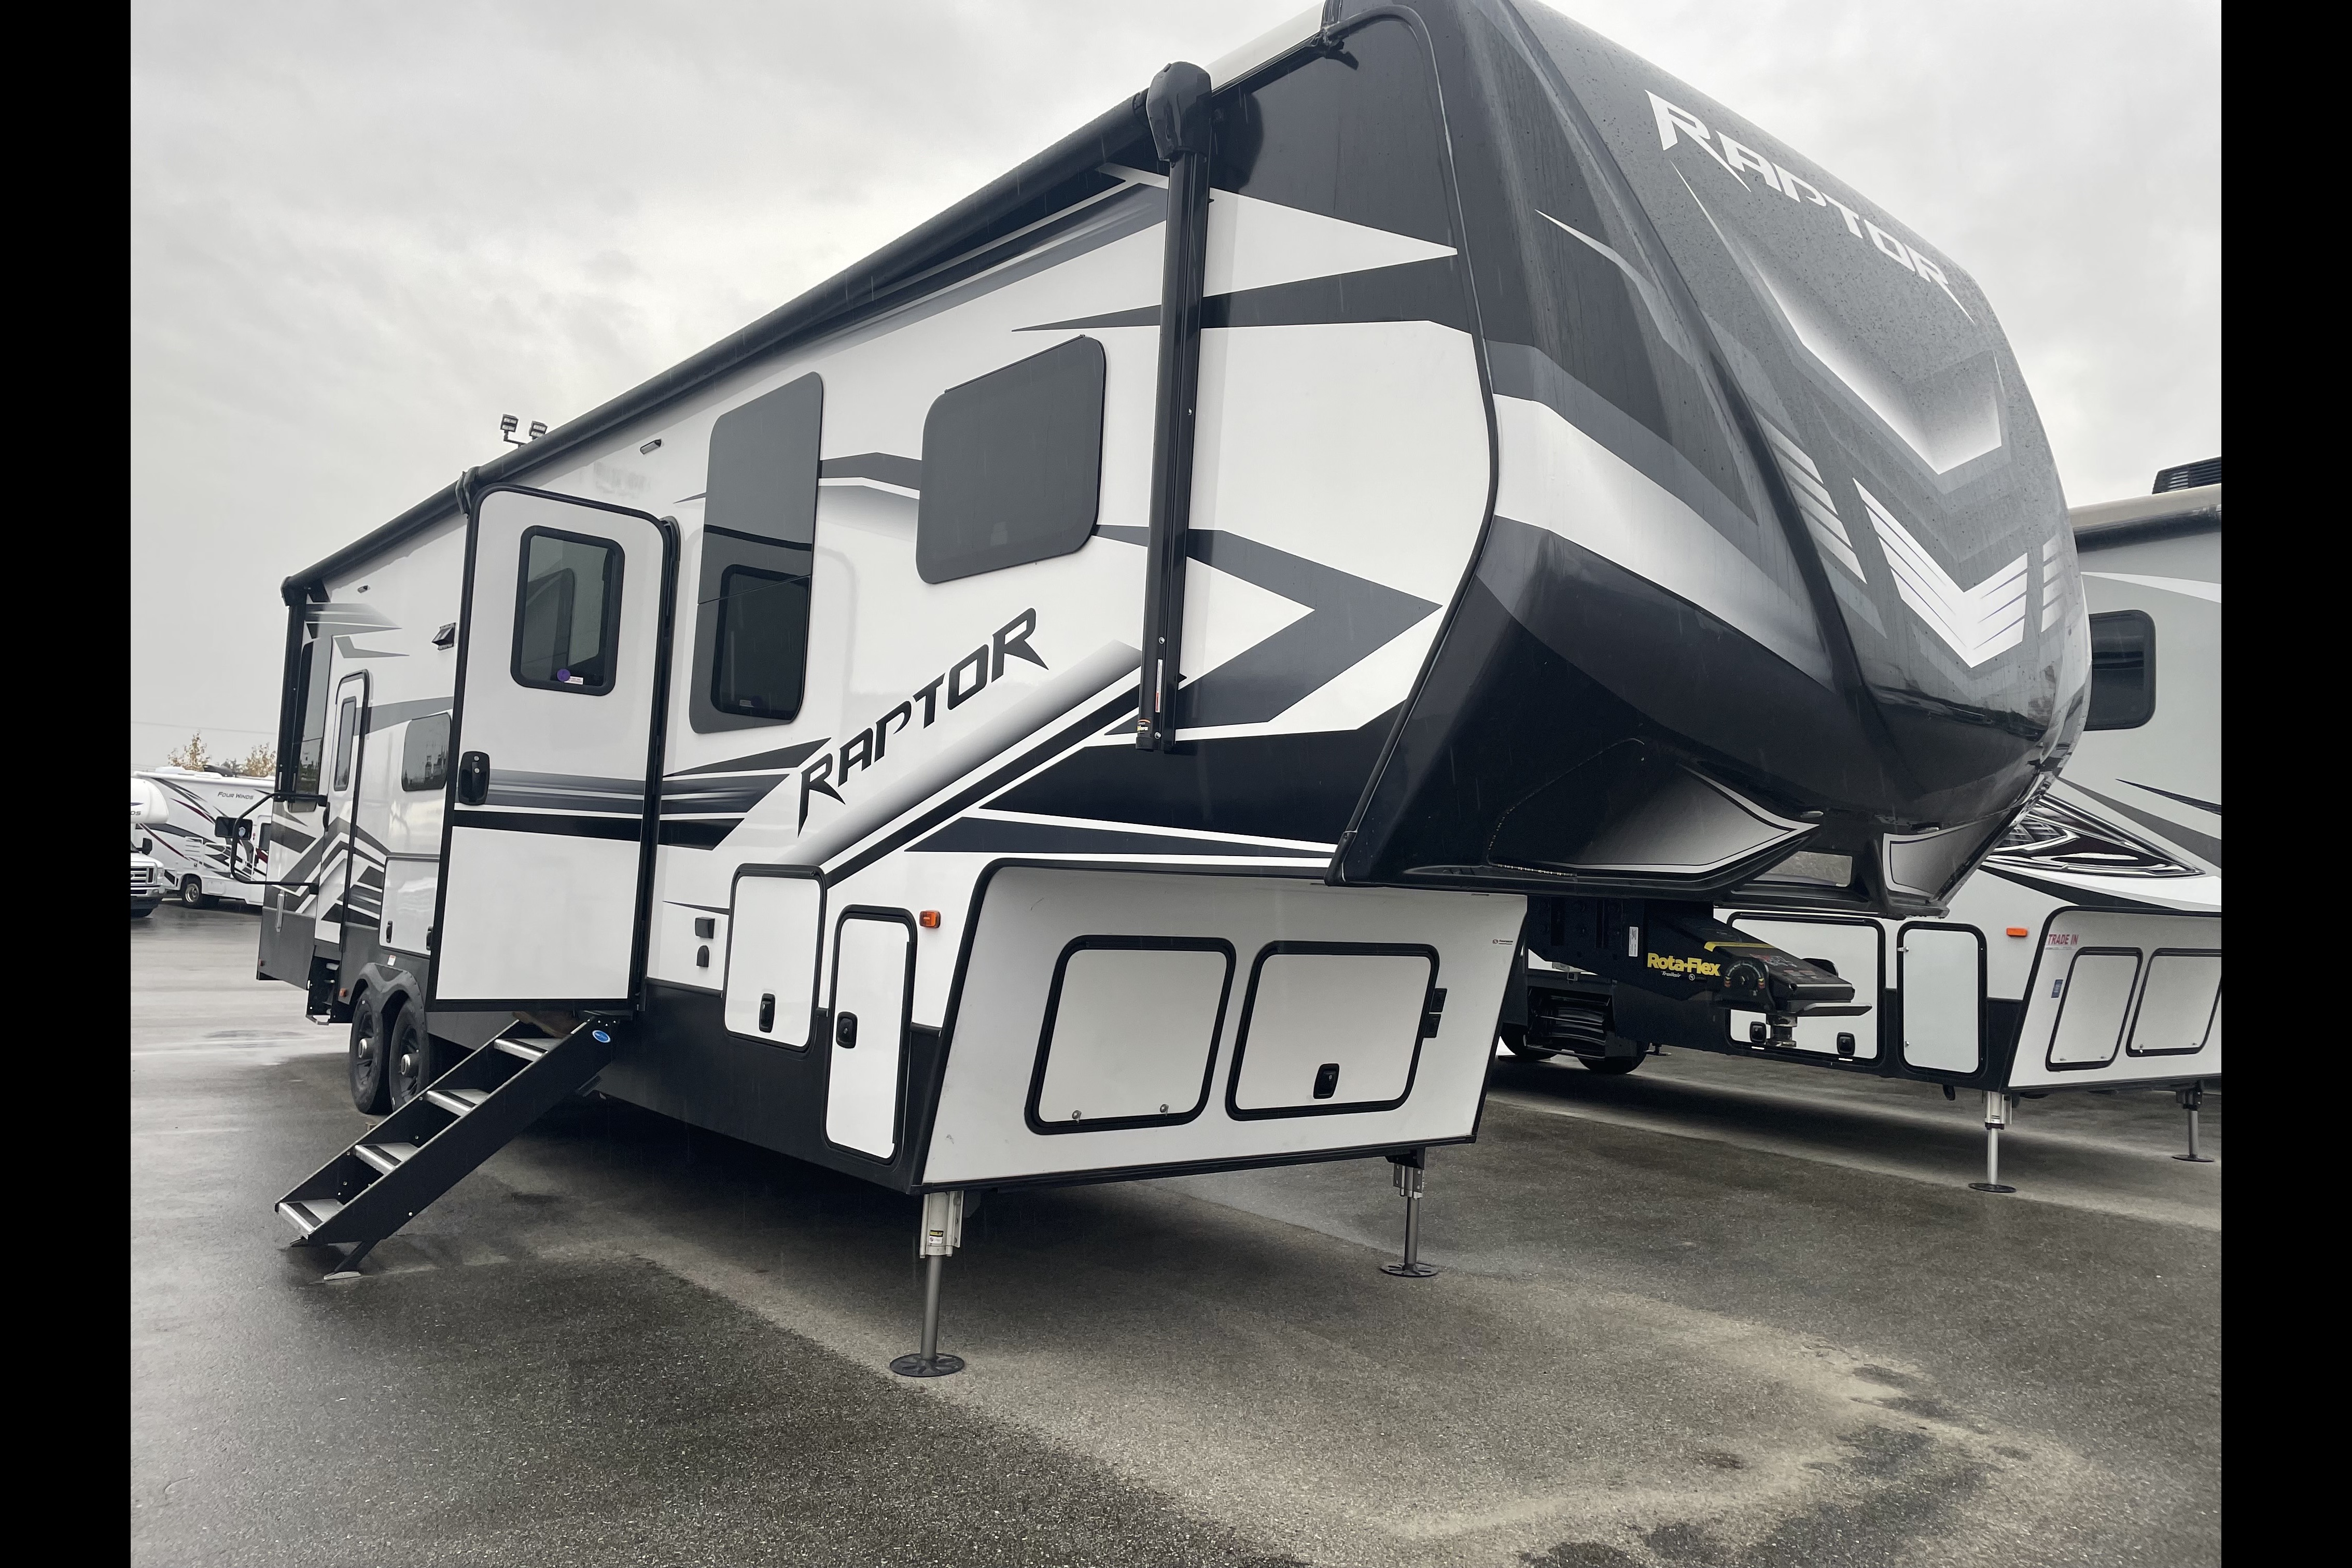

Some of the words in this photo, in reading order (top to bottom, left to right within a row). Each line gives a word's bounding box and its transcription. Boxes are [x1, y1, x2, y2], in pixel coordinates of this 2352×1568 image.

[1645, 89, 1975, 325] RAPTOR
[797, 607, 1049, 838] RAPTOR
[2048, 934, 2070, 945] TRADE
[2070, 934, 2079, 945] IN
